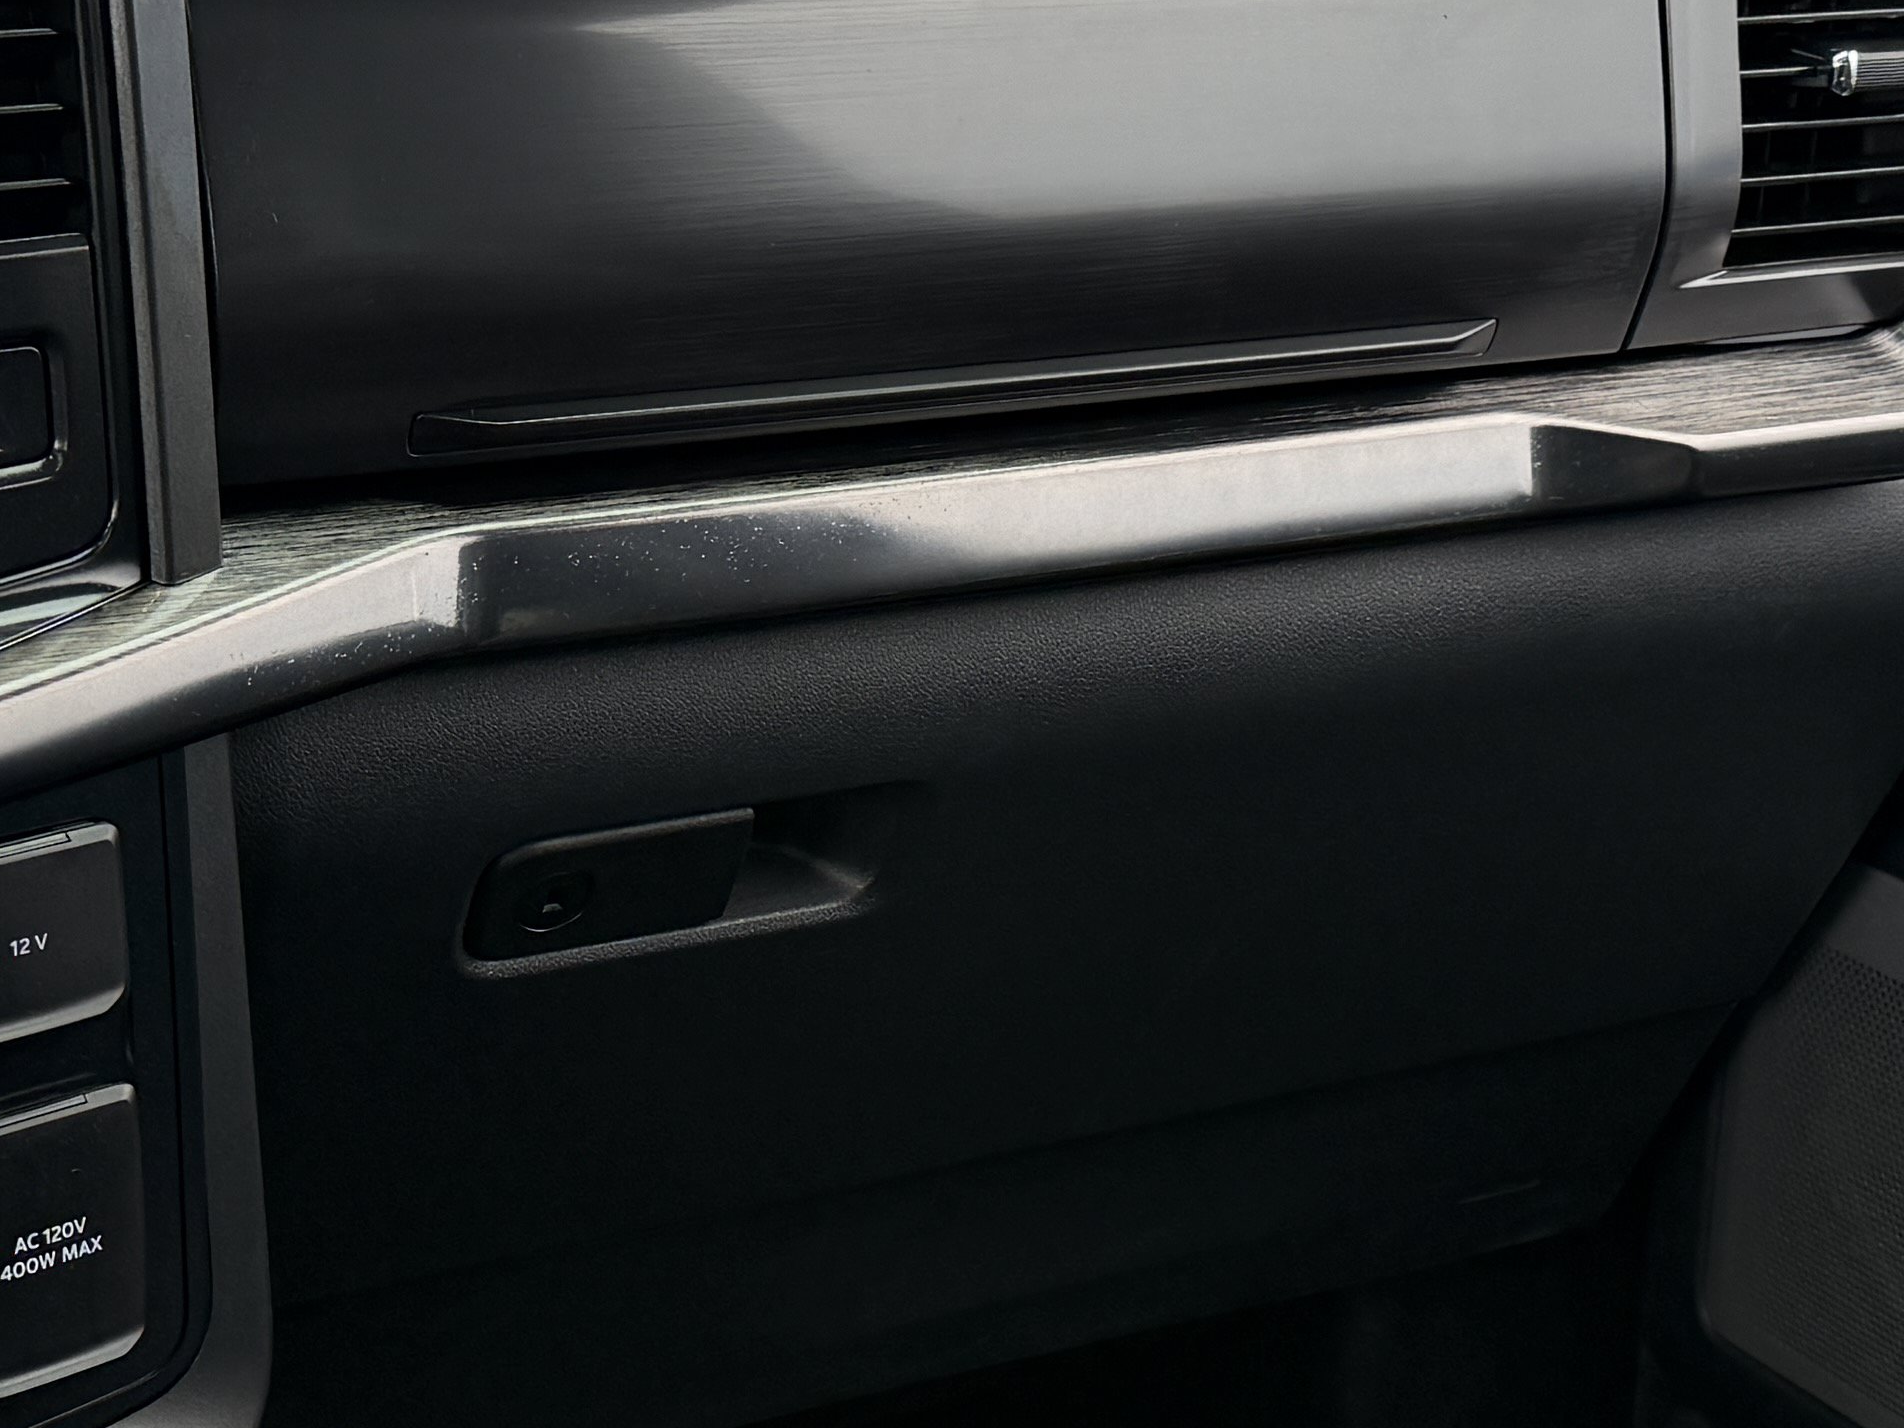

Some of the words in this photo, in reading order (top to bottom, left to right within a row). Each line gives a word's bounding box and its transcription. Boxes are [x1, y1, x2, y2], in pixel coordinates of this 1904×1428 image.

[9, 937, 31, 957] 12
[34, 932, 48, 950] V
[14, 1232, 40, 1255] AC
[42, 1216, 87, 1245] 120V
[0, 1250, 56, 1281] 400W
[62, 1234, 104, 1263] MAX
